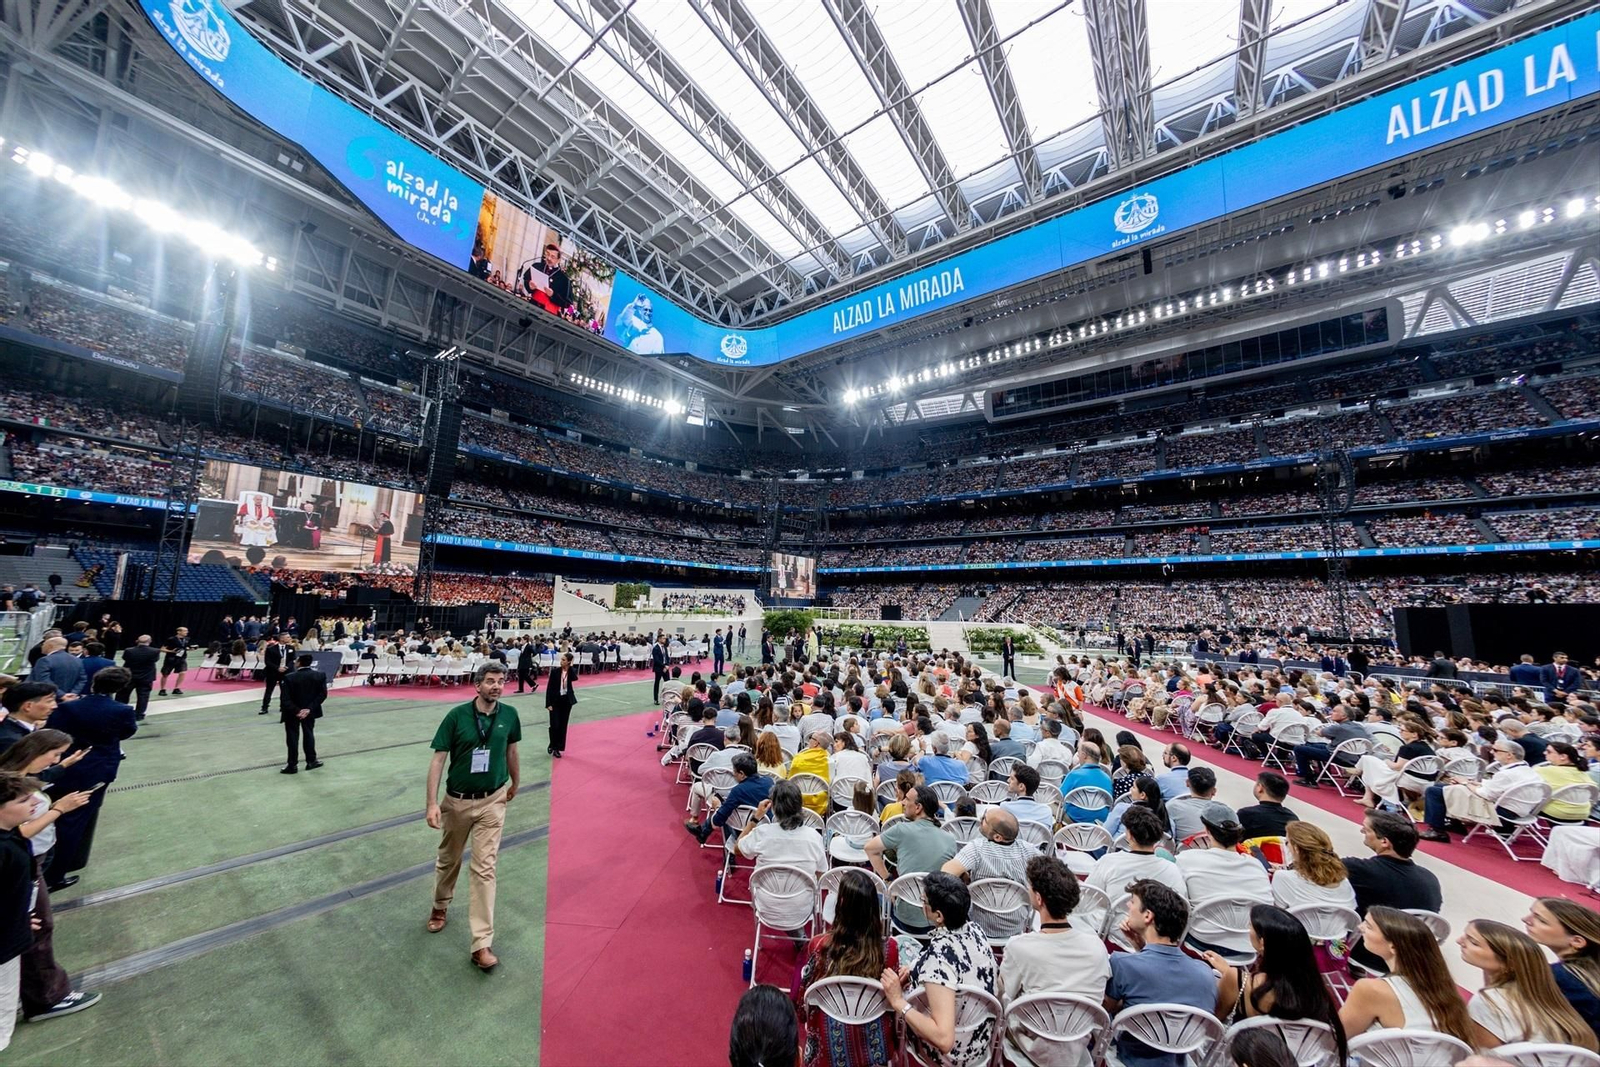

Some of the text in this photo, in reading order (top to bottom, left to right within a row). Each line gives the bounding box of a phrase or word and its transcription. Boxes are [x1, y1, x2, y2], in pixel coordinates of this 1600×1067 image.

[188, 52, 225, 88] mirada
[1386, 68, 1505, 145] ALZAD
[1524, 42, 1577, 97] LA
[386, 160, 458, 211] alzad la
[387, 180, 452, 224] mirada
[833, 267, 965, 334] ALZAD LA MIRADA
[115, 496, 139, 506] ALZAD
[141, 499, 150, 508] LA
[436, 535, 453, 545] ALZAD
[462, 538, 483, 548] MIRADA
